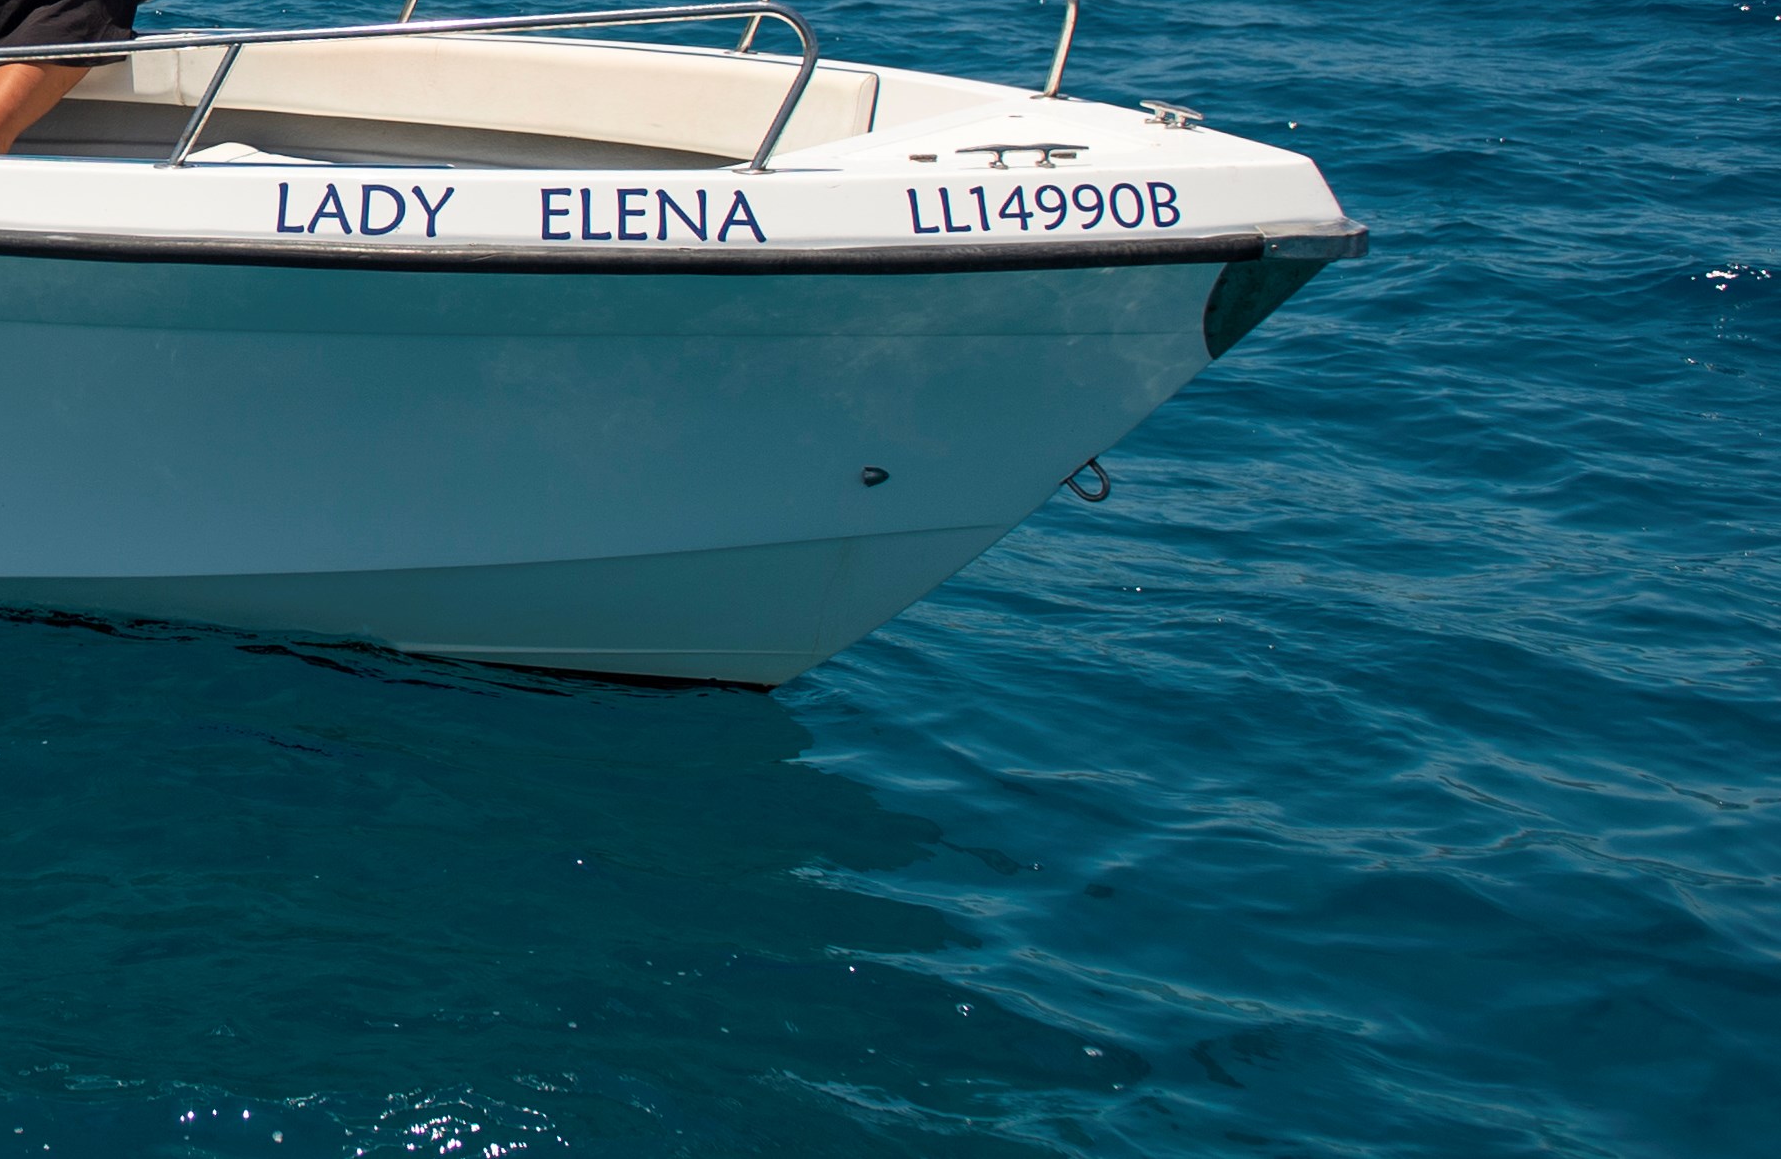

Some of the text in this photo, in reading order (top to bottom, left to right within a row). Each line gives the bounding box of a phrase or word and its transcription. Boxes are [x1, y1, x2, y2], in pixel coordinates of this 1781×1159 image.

[275, 181, 768, 245] LADY ELENA
[905, 180, 1182, 235] LL14990B
